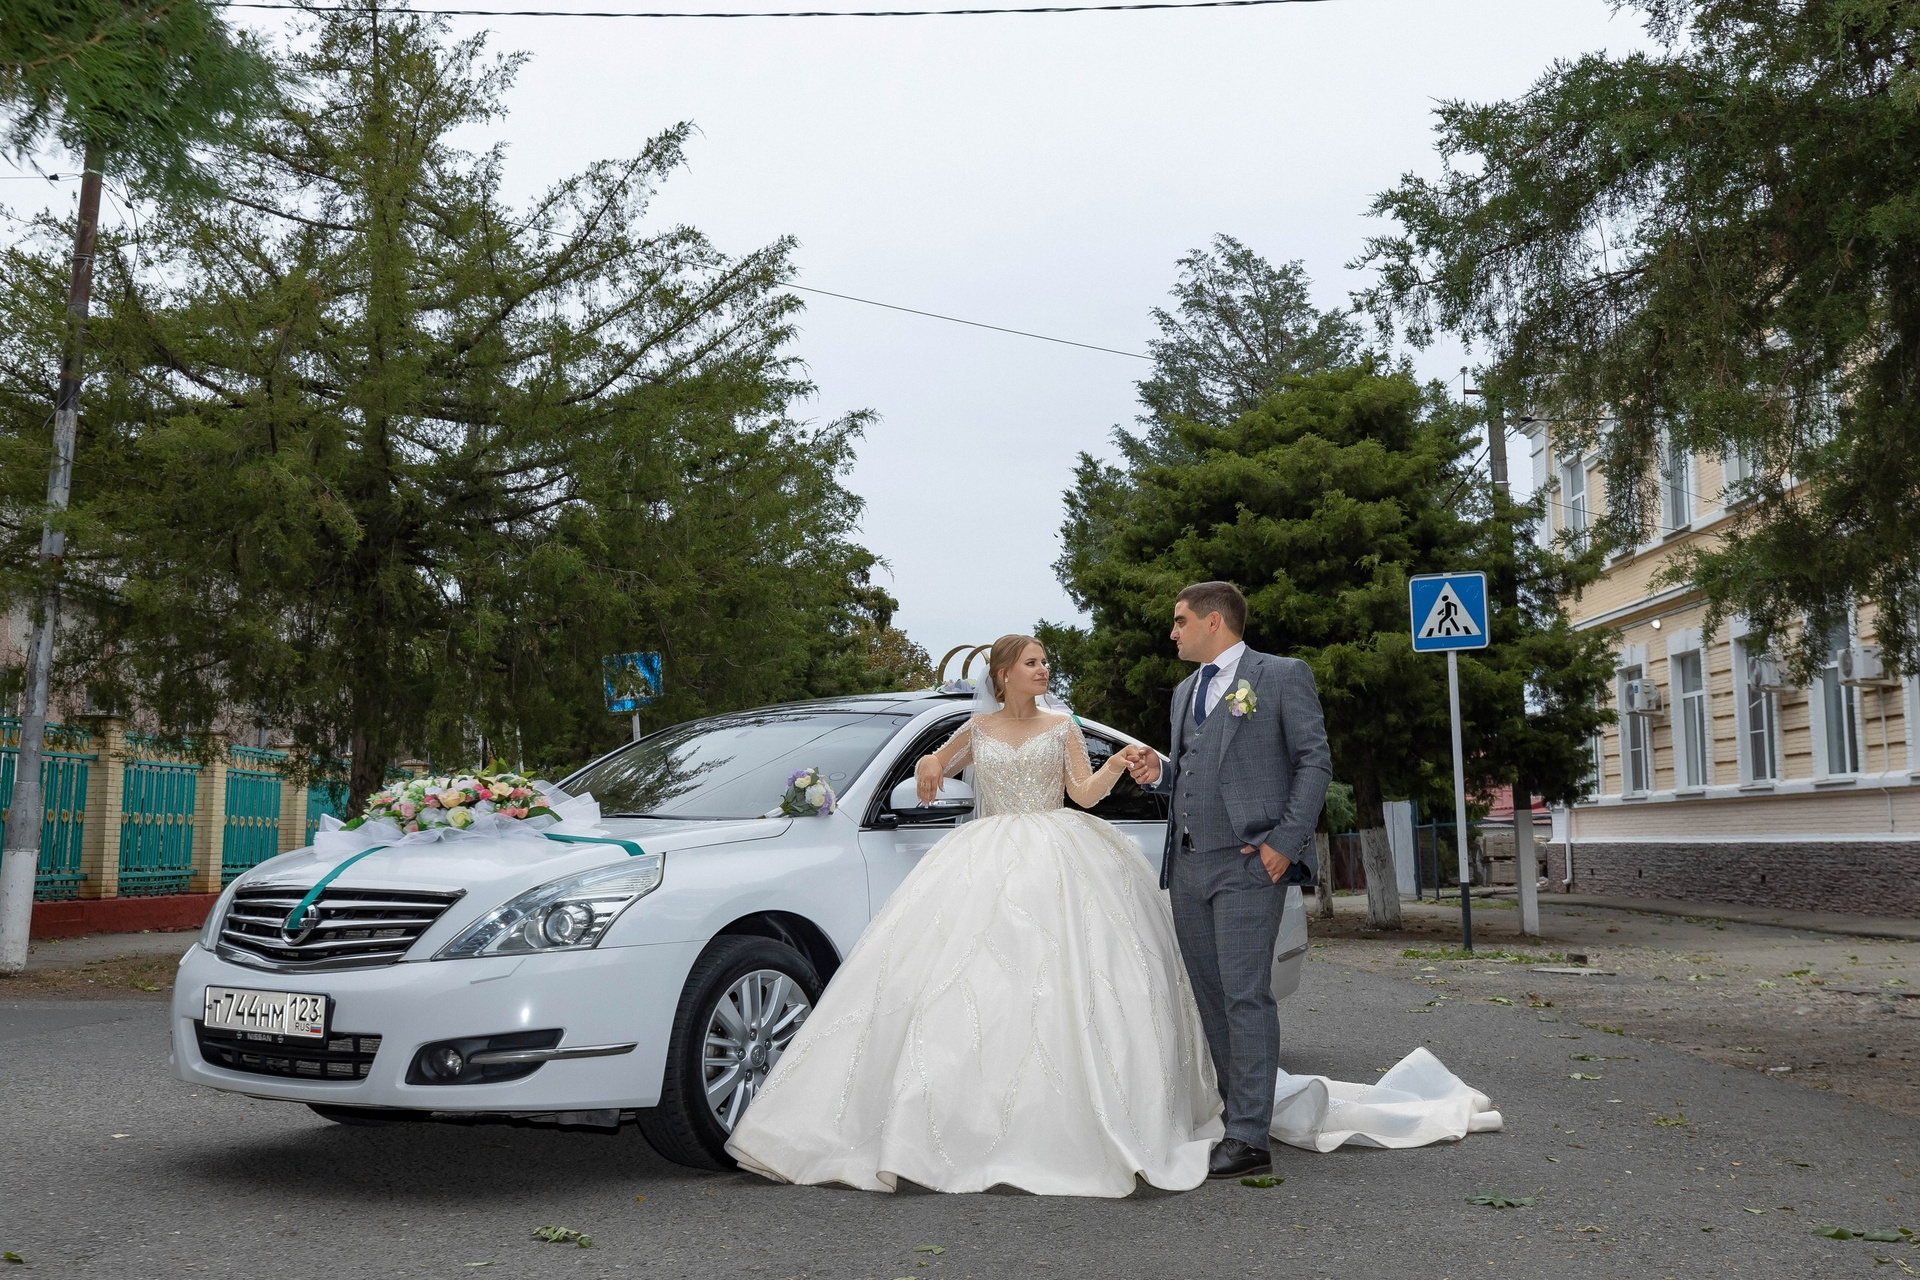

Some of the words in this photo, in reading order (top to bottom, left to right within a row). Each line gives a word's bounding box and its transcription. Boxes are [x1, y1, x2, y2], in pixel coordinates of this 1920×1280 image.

[290, 996, 322, 1022] 123
[294, 1022, 310, 1032] RUS
[247, 1033, 272, 1042] NISSAN
